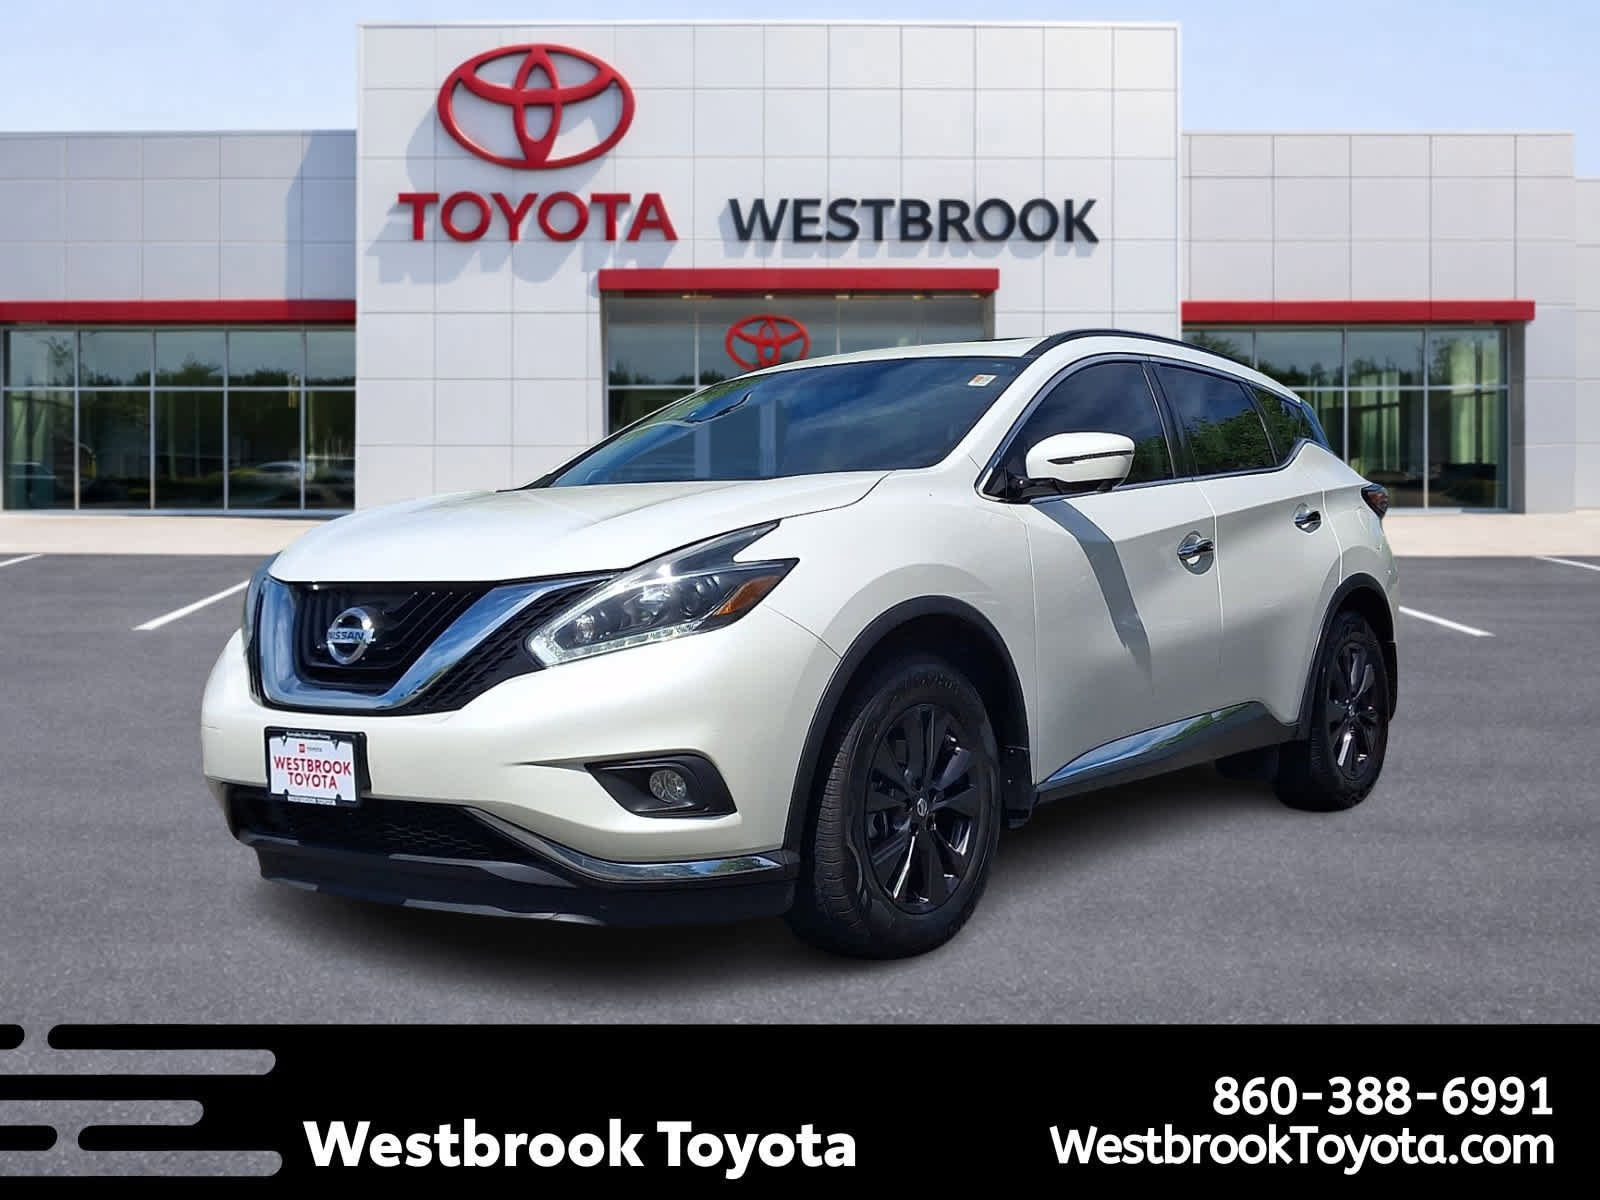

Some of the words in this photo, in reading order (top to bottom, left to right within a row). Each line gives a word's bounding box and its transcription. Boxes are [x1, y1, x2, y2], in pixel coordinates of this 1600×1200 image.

[399, 192, 677, 241] TOYOTA
[729, 198, 1098, 243] WESTBROOK
[328, 631, 364, 641] NISSAN
[274, 756, 351, 775] WESTBROOK
[288, 772, 337, 790] TOYOTA
